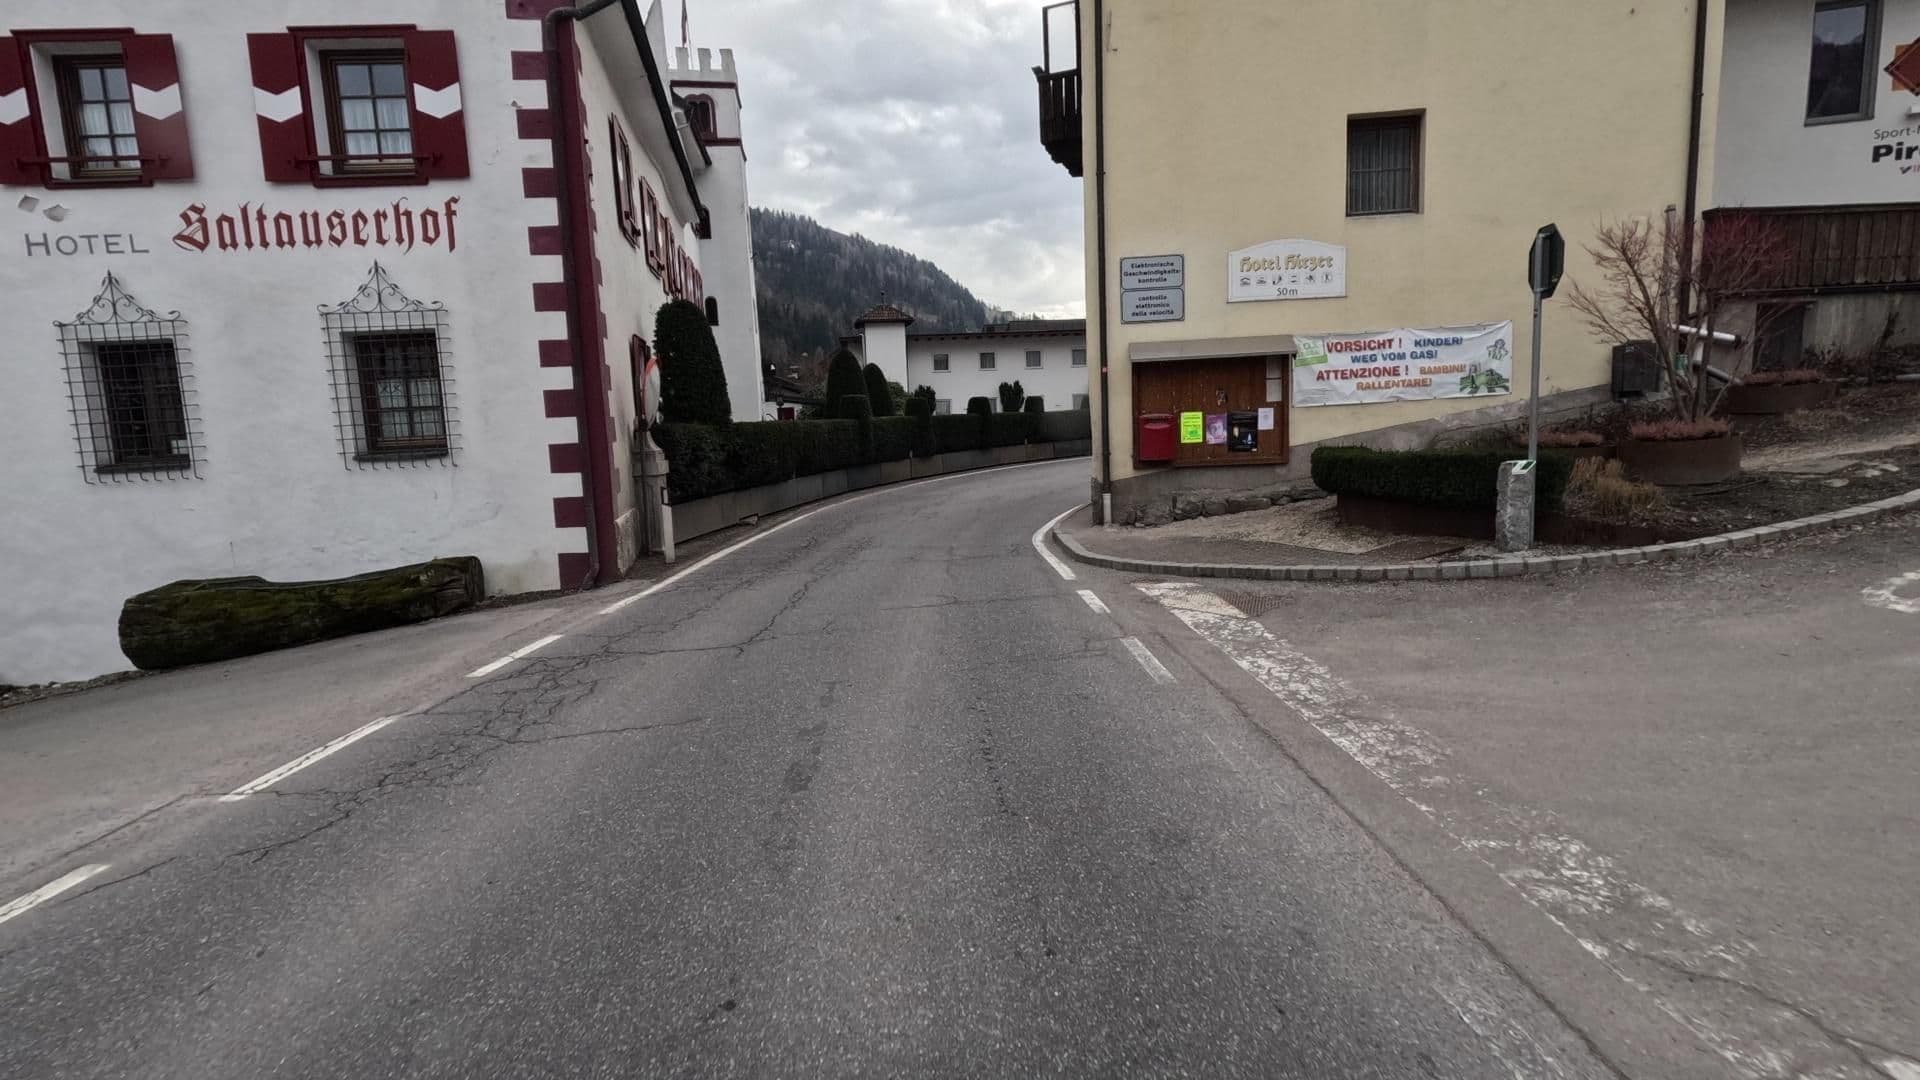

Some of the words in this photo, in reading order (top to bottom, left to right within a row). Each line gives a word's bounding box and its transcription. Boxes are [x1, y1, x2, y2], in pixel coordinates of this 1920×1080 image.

[1872, 141, 1920, 163] Pir
[24, 231, 150, 257] HOTEL
[171, 195, 461, 256] Saltauserhof
[1131, 261, 1174, 269] Elektronische
[1240, 255, 1281, 272] Hotel
[1326, 339, 1394, 353] VORSICHT
[1414, 336, 1463, 348] KINDER!
[1350, 353, 1378, 364] WEG
[1381, 351, 1407, 362] VOM
[1410, 349, 1438, 360] GAS!
[1316, 365, 1401, 381] ATTENZIONE
[1356, 378, 1433, 391] RALLENTARE!
